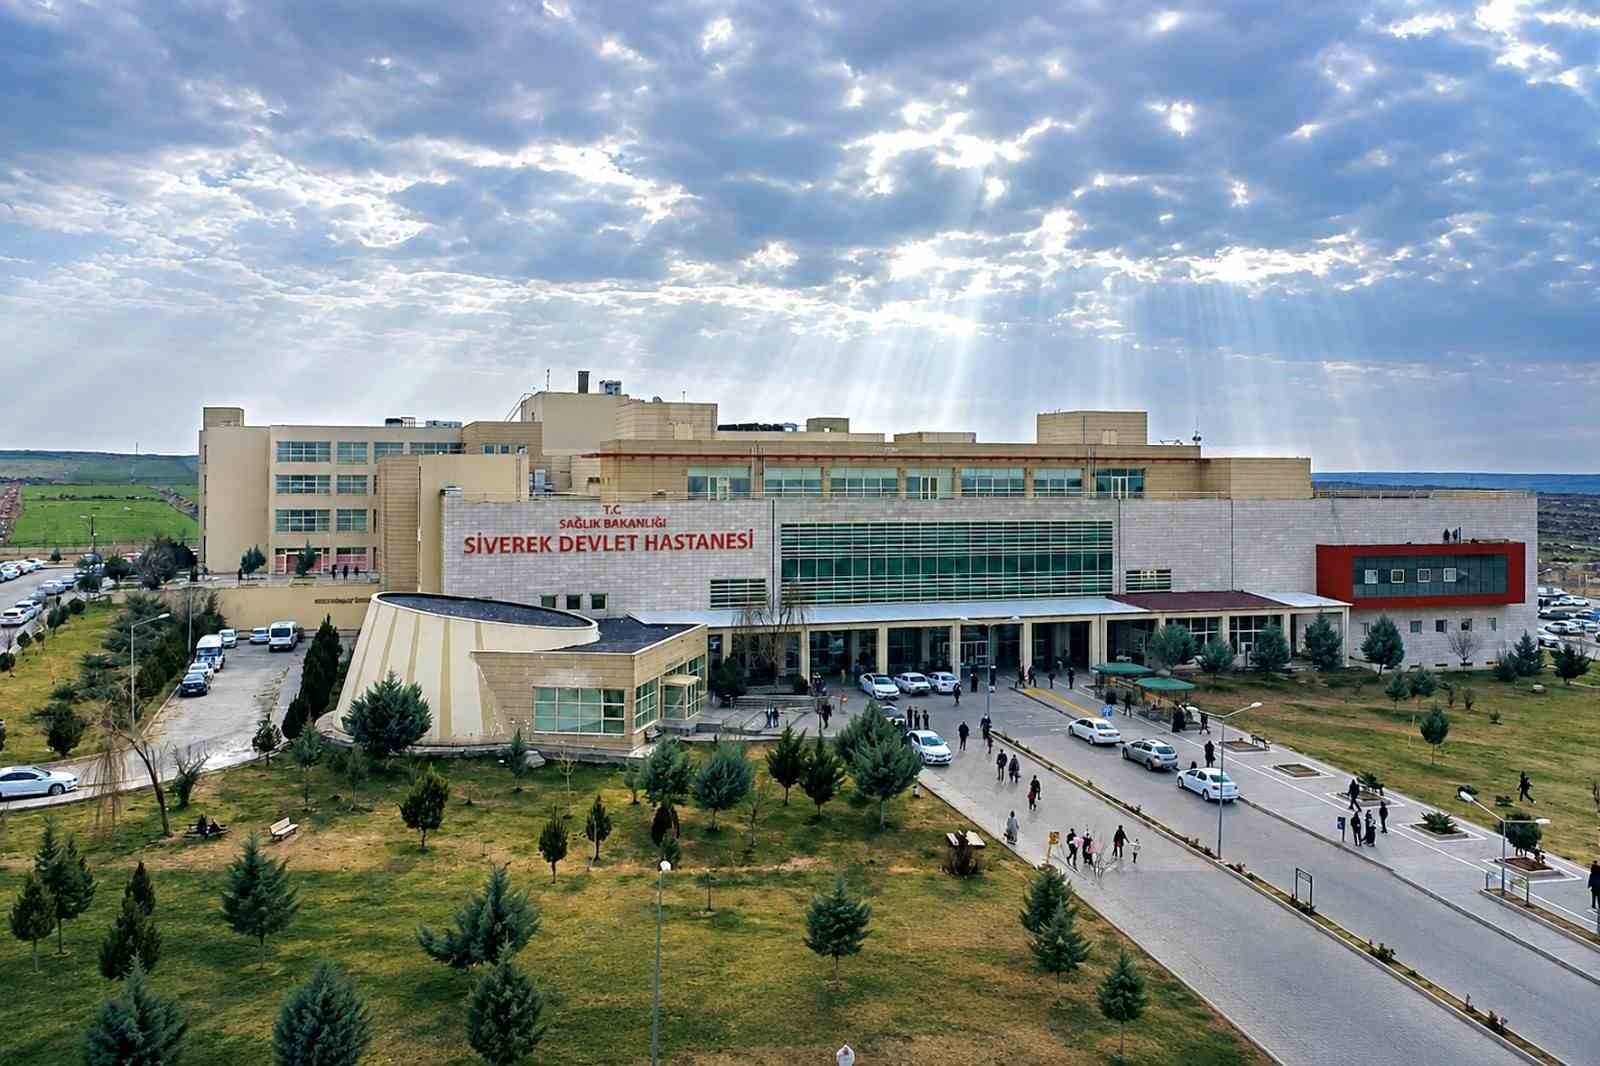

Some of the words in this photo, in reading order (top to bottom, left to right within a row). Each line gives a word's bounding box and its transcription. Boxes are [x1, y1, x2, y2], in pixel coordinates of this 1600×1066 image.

[559, 515, 600, 529] SAĞLIK
[604, 515, 666, 529] BAKANLIĞI
[464, 532, 552, 554] SİVEREK
[559, 534, 639, 552] DEVLET
[644, 528, 754, 551] HASTANESİ
